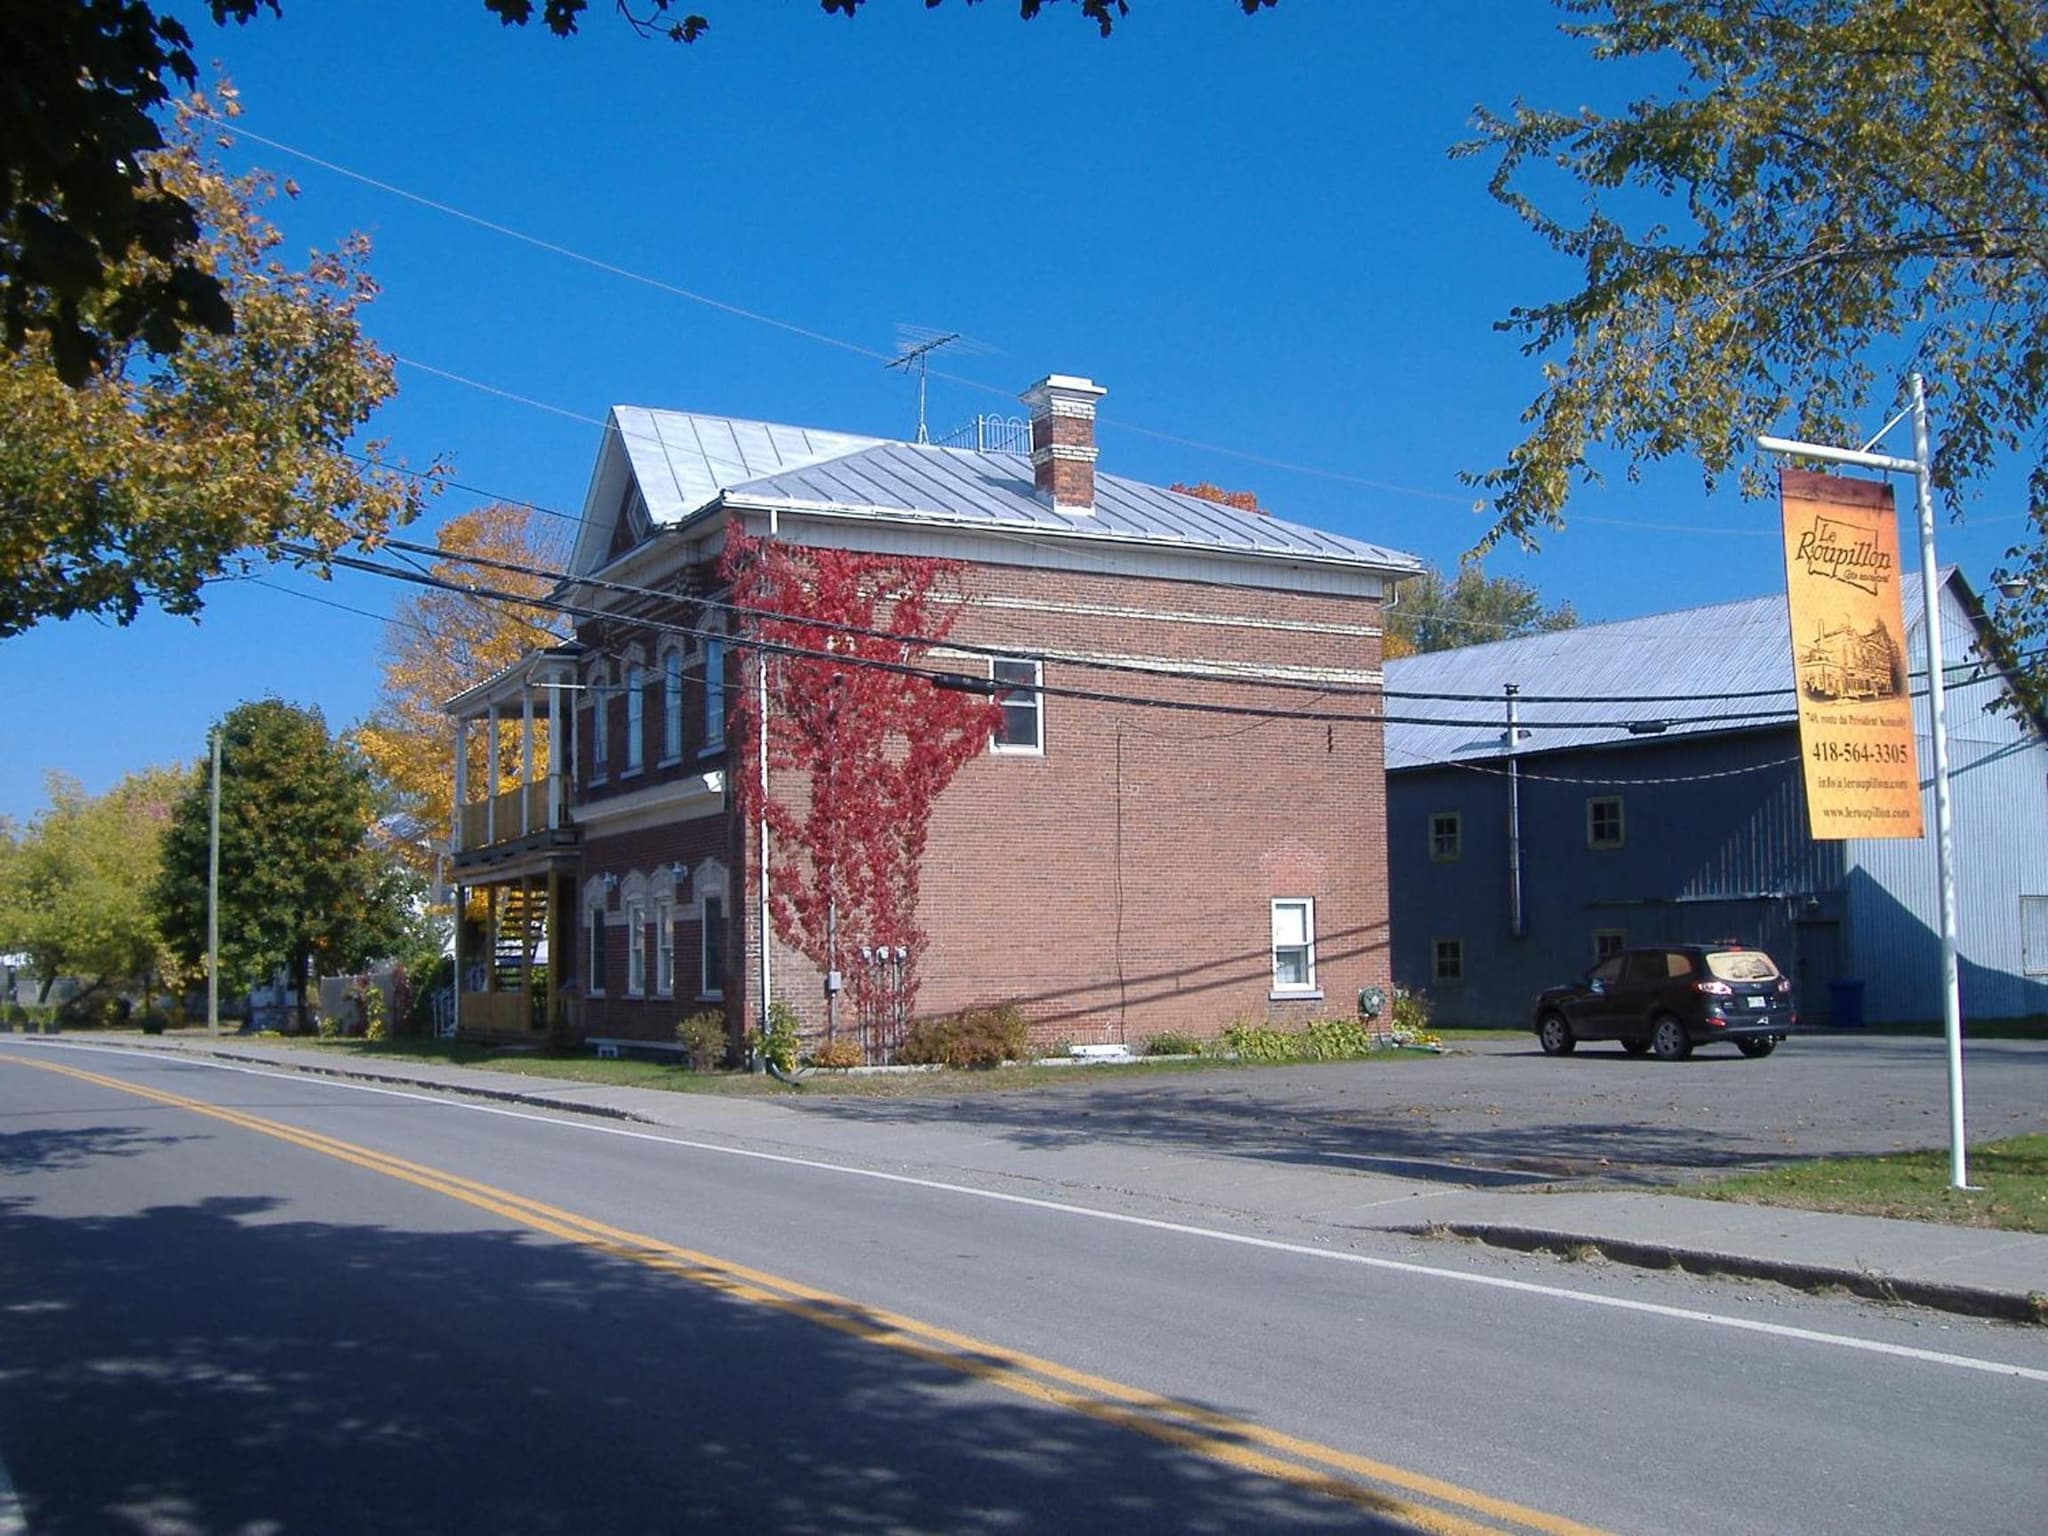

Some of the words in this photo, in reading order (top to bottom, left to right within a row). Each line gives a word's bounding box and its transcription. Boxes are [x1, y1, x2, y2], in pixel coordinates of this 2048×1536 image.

[1819, 523, 1837, 542] Le
[1795, 531, 1891, 578] Roupillon
[1812, 742, 1908, 763] 418-564-3305
